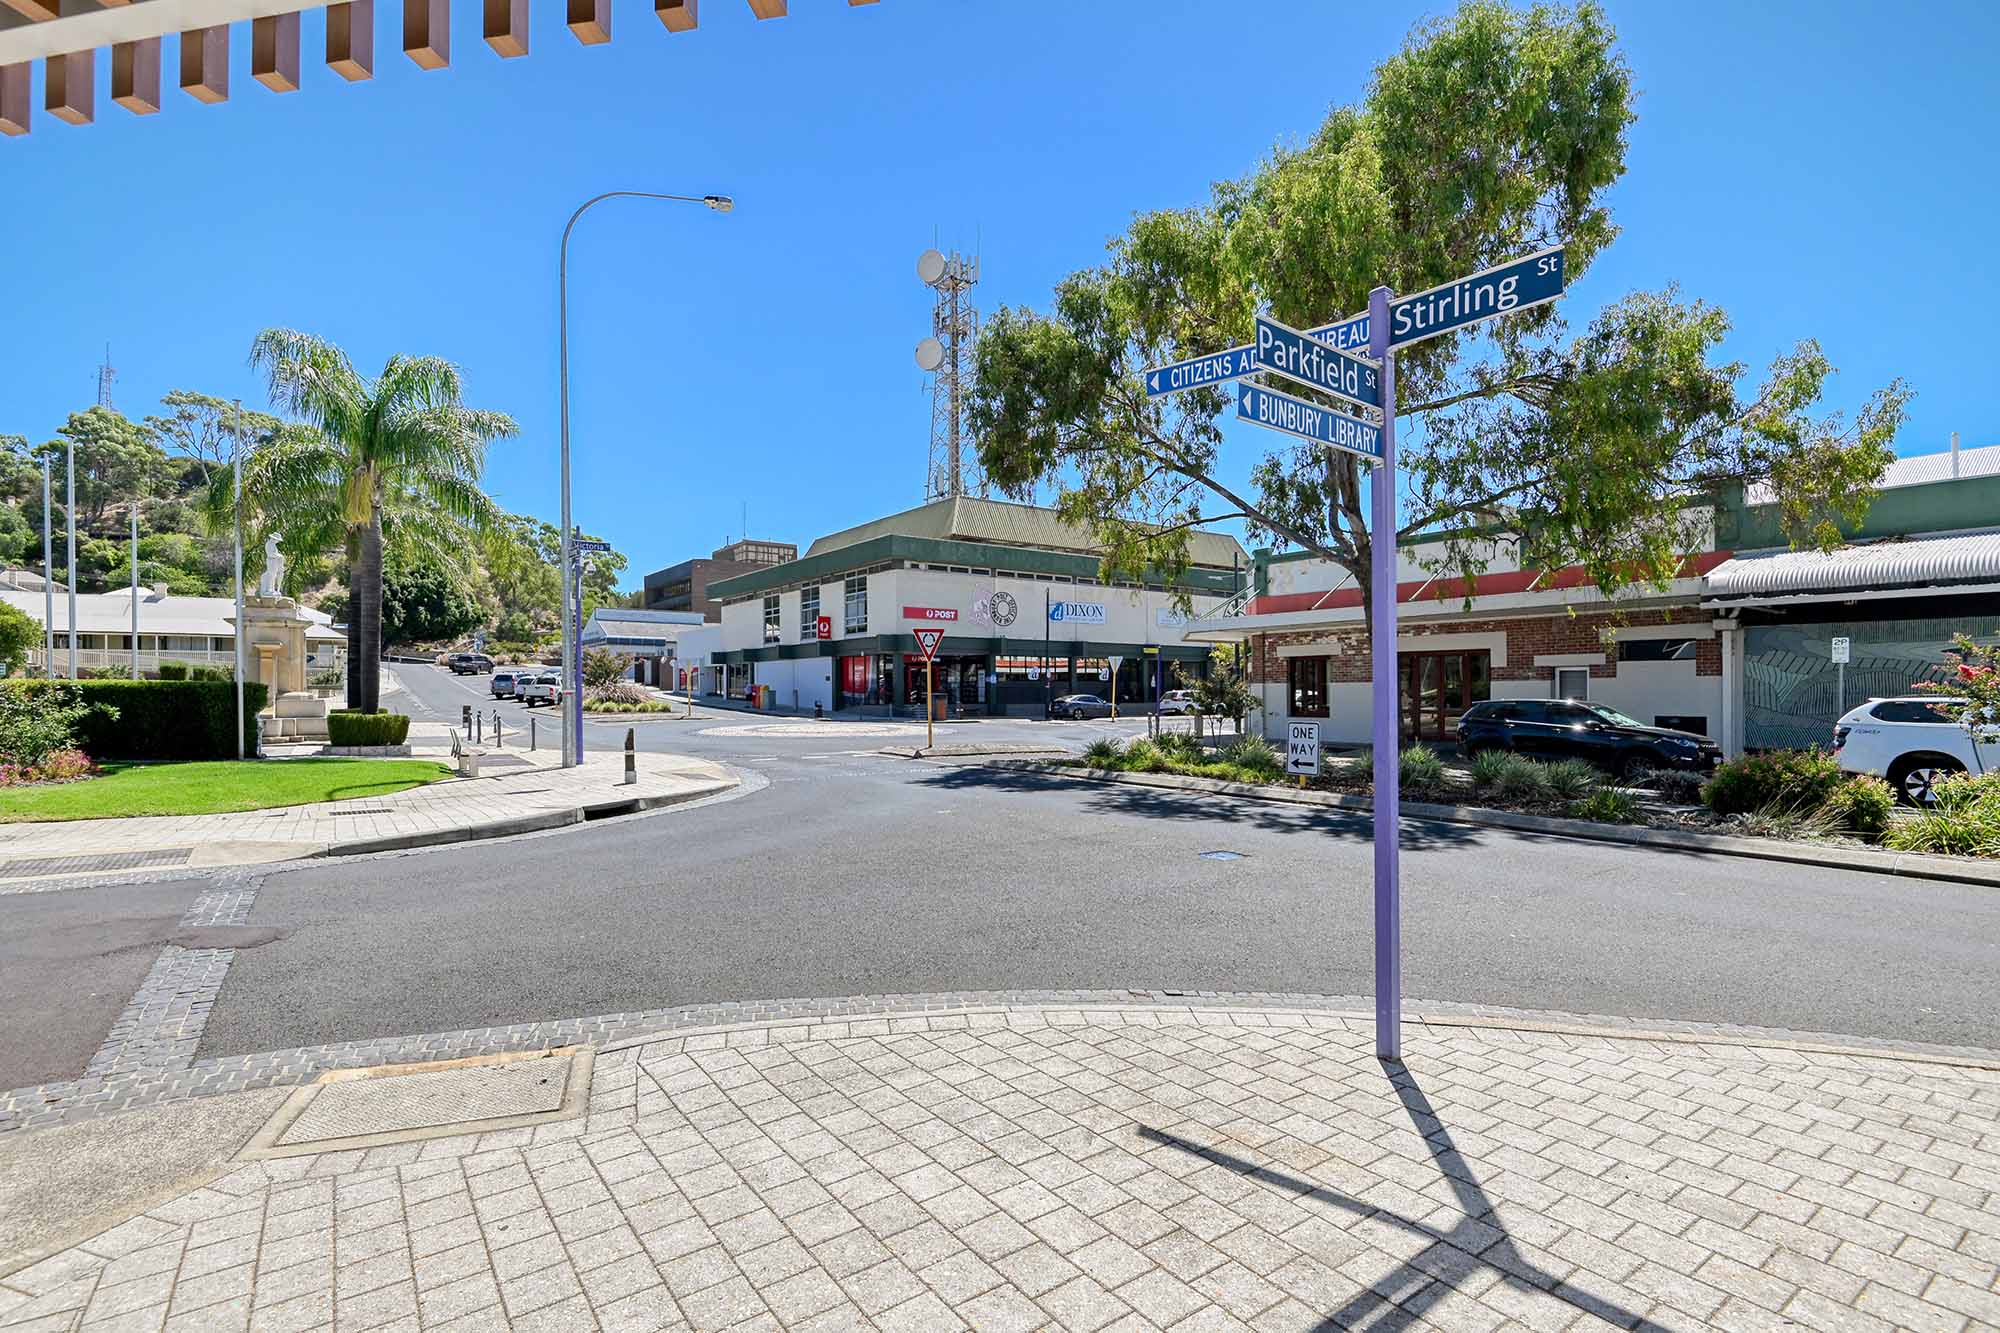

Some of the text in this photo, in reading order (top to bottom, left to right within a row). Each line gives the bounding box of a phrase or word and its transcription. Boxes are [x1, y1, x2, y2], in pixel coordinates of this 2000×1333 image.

[1394, 256, 1558, 336] Stirling St
[1170, 355, 1232, 388] CITIZENS
[1314, 320, 1370, 348] REAU
[1259, 325, 1376, 396] Parkfield St
[1259, 393, 1377, 454] BUNBURY LIBRARY
[934, 610, 956, 619] POST
[1066, 603, 1104, 618] DIXON
[1833, 638, 1848, 646] 2P
[1292, 726, 1314, 740] ONE
[1290, 743, 1316, 756] WAY
